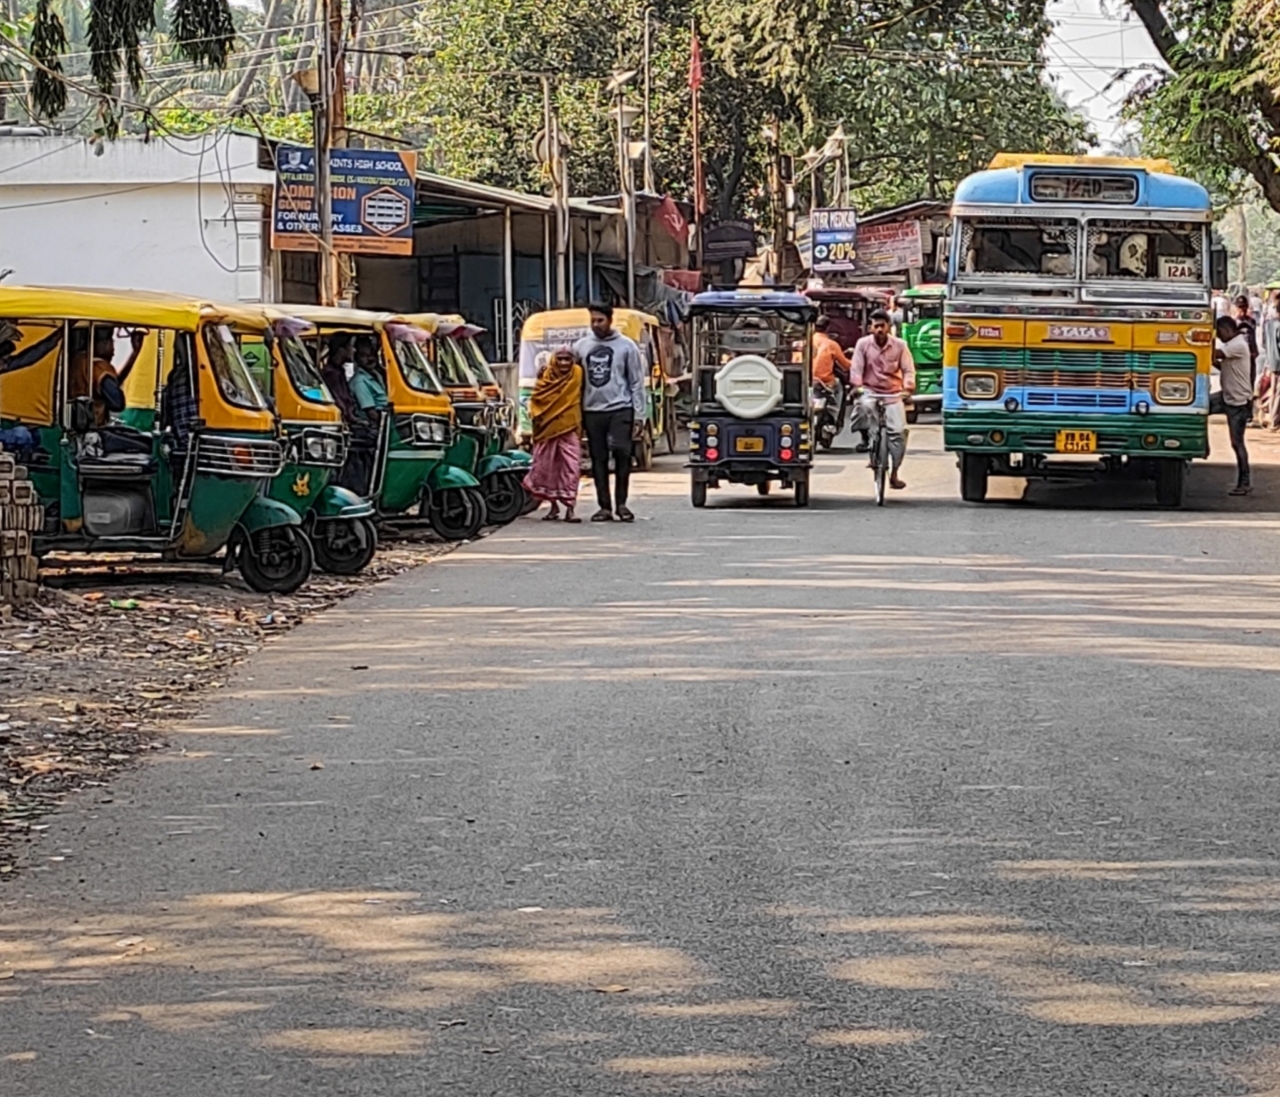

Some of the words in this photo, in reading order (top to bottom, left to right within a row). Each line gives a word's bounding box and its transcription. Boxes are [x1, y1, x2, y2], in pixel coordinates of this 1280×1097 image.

[329, 158, 353, 169] AINTS
[353, 159, 374, 170] HIGH
[374, 160, 405, 172] SCHOOL
[277, 212, 297, 220] FOR
[331, 224, 363, 234] ASSES
[829, 243, 856, 260] 20%
[547, 328, 587, 340] PORT
[1062, 326, 1097, 337] TATA
